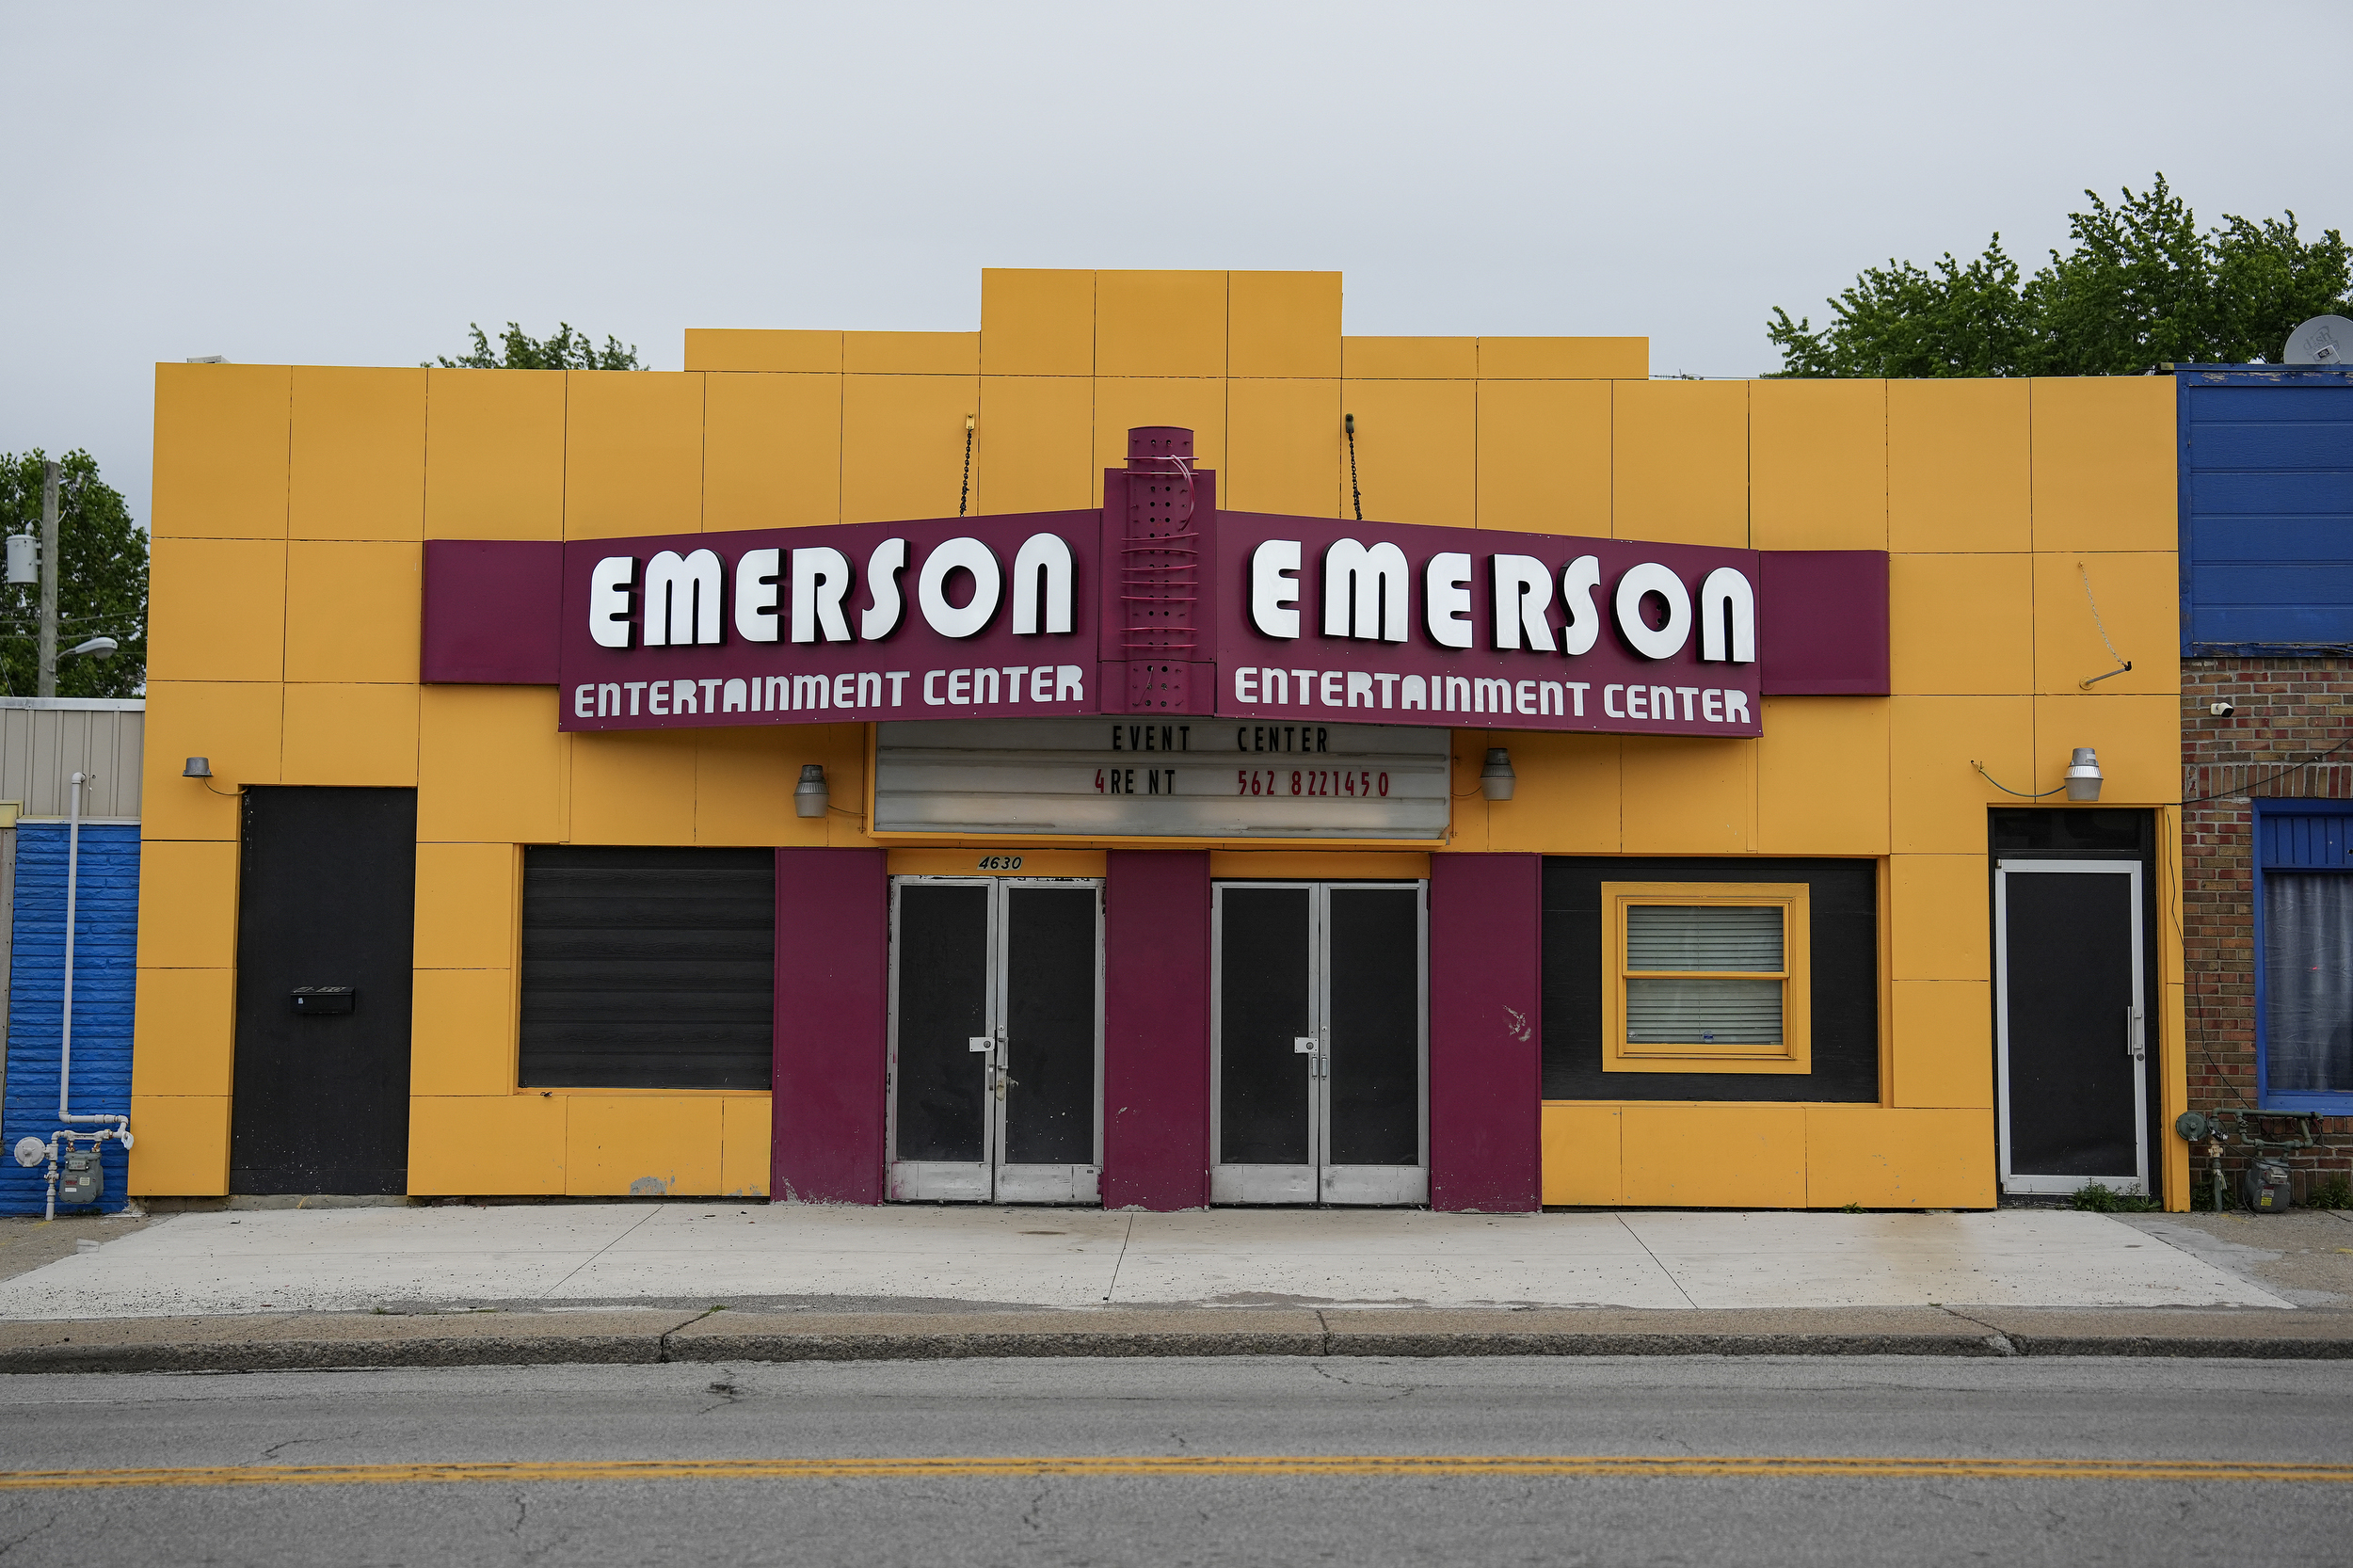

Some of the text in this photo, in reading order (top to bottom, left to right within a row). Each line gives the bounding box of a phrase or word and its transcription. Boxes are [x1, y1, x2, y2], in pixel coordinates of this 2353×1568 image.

[588, 532, 1076, 648] EMERSON
[1249, 537, 1756, 664] EMERSON
[574, 664, 1084, 718] ENTERTAINMENT CENTER
[1235, 666, 1752, 724] ENTERTAINMENT CENTER
[1112, 725, 1328, 752] EVENT CENTER
[1238, 770, 1275, 795] 562
[1291, 770, 1389, 796] 8221450
[978, 856, 1022, 870] 4630
